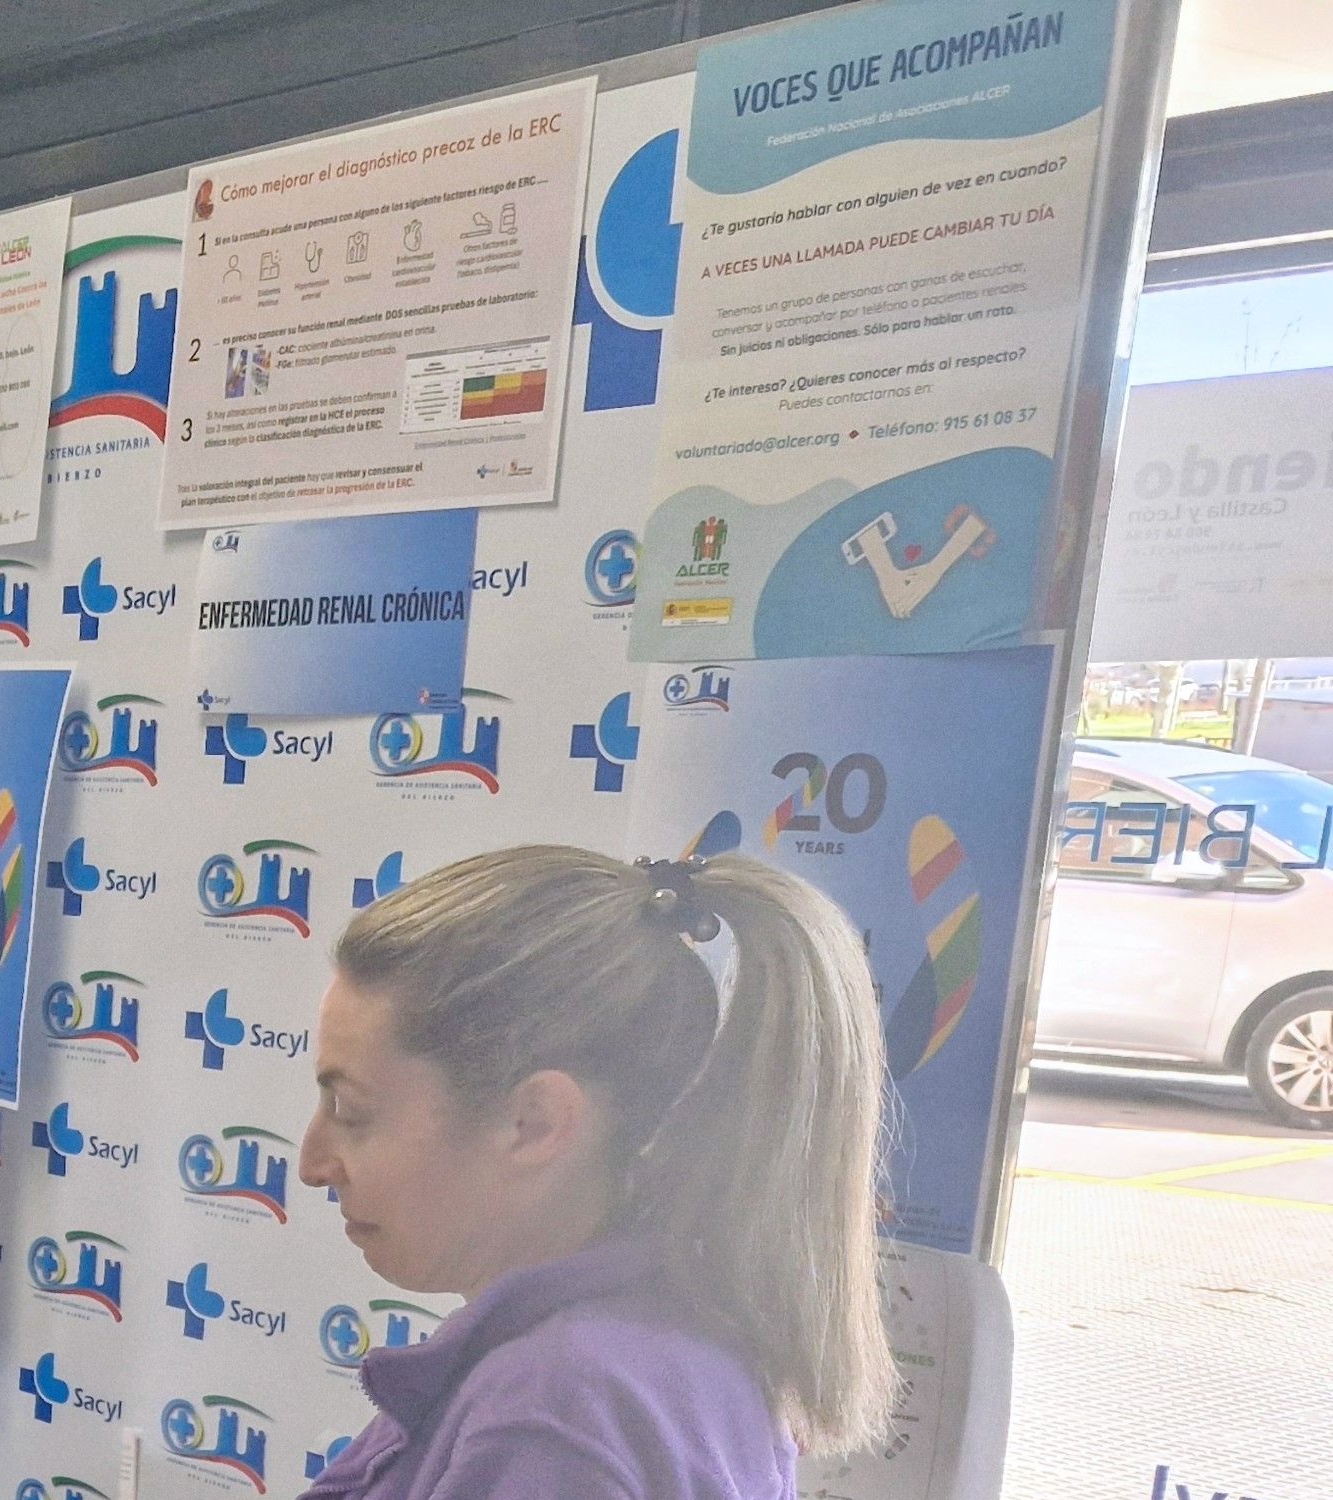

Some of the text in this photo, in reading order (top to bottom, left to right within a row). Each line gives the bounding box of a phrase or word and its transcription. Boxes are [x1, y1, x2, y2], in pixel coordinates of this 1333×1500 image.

[734, 11, 1063, 116] VOCES QUE ACOMPAÑAN
[221, 114, 561, 202] Cómo mejorar el diagnóstico precoz de la ERC
[702, 156, 1067, 240] ¿Te gustaría hablar con alguien de vez en cuando?
[701, 204, 1054, 279] A VECES UNA LLAMADA PUEDE CAMBIAR TU DÍA
[705, 347, 1026, 403] ¿Te interesa? ¿Quieres conocer más al respecto?
[676, 407, 1037, 459] voluntariado@alcer.org Teléfono: 915 61 08 37
[470, 560, 527, 594] acyl
[123, 584, 175, 615] Sacyl
[199, 586, 464, 629] ENFERMEDAD RENAL CRÓNICA
[273, 730, 332, 758] Sacyl
[769, 750, 889, 835] 20
[796, 841, 845, 855] YEARS
[105, 869, 156, 899] Sacyl
[250, 1024, 308, 1058] Sacyl
[89, 1136, 138, 1168] Sacyl
[74, 1388, 122, 1422] Sacyl
